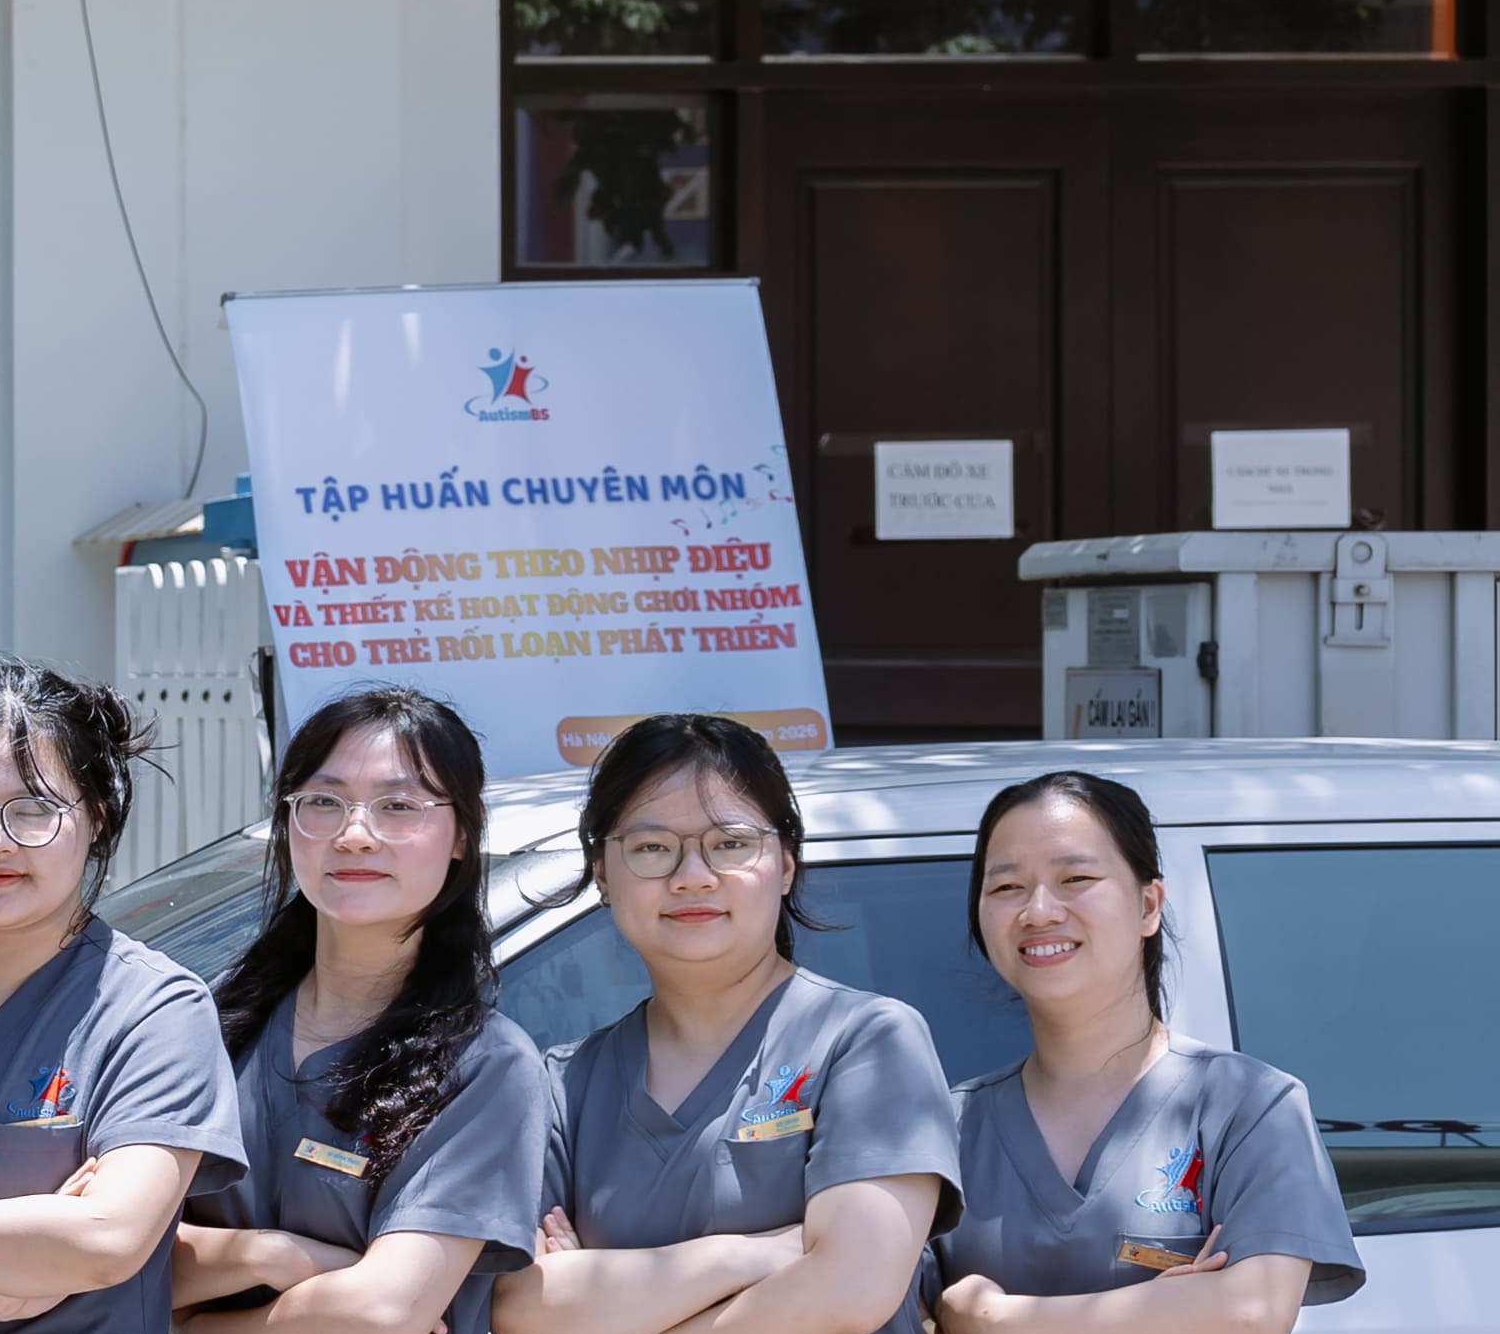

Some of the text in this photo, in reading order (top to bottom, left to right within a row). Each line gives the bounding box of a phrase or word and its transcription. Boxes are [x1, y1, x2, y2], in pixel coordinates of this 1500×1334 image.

[478, 407, 550, 421] AutismBS
[294, 463, 747, 522] TẬP HUẤN CHUYÊN MÔN
[284, 536, 772, 595] VẬN ĐỘNG THEO NHỊP ĐIỆU
[272, 582, 802, 628] VÀ THIẾT KẾ HOẠT ĐỘNG CHƠI NHÓM
[288, 612, 798, 669] CHO TRẺ RỐI LOẠN PHÁT TRIỂN
